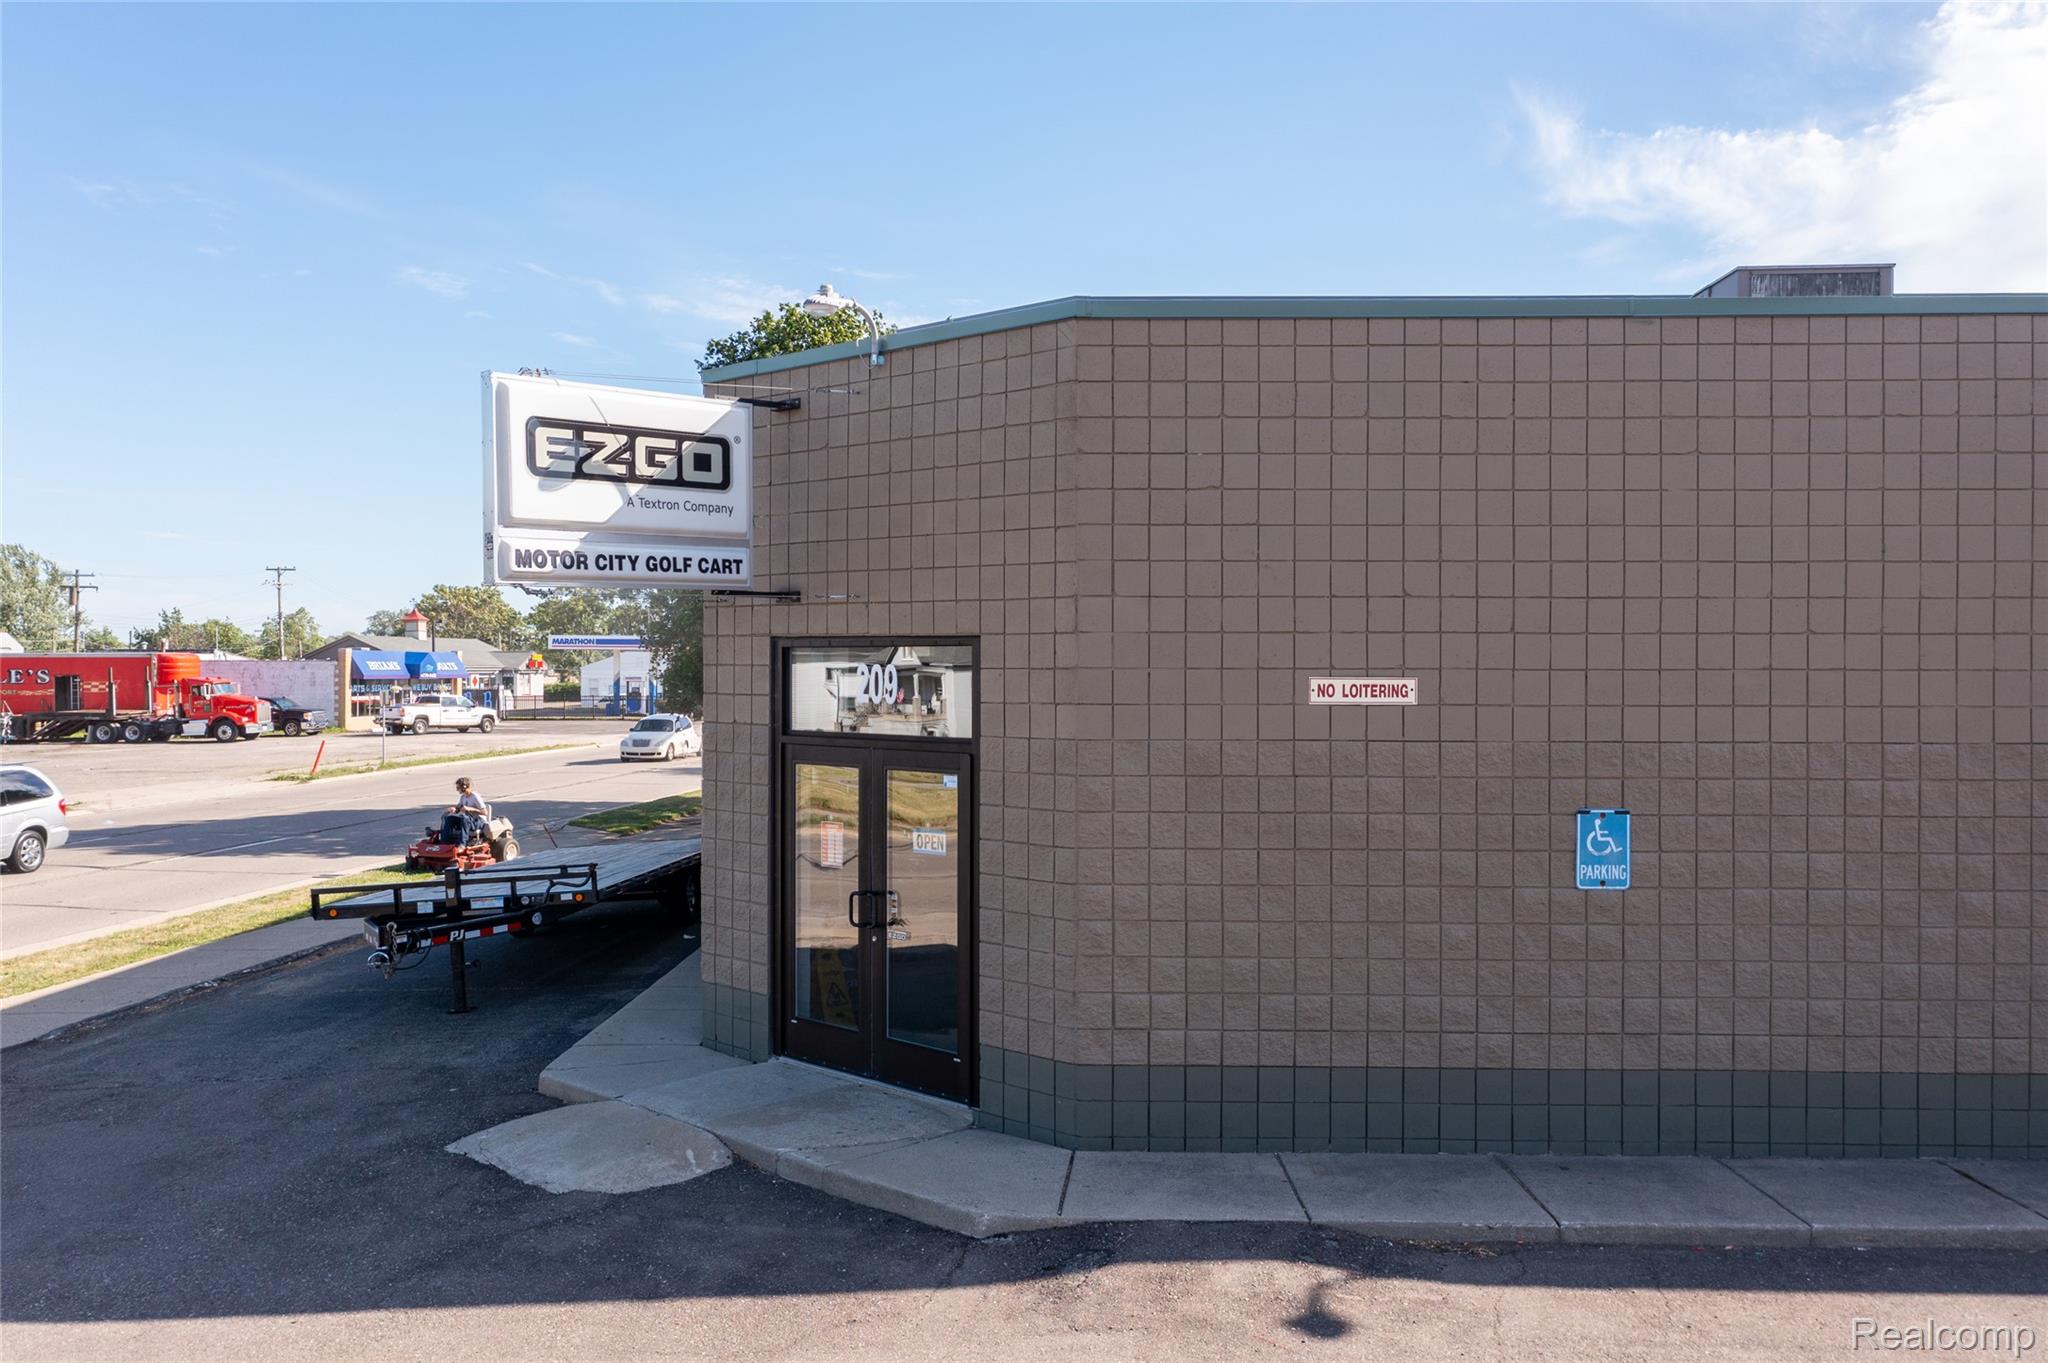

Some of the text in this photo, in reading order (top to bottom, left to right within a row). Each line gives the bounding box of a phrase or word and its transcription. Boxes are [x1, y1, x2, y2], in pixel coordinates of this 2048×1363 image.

[626, 497, 735, 517] A Textron Company
[514, 548, 744, 575] MOTOR CITY GOLF CART
[856, 662, 898, 705] 209
[1316, 683, 1409, 699] NO LOITERING
[916, 833, 945, 851] OPEN
[1580, 864, 1627, 880] PARKING
[450, 929, 465, 942] PJ
